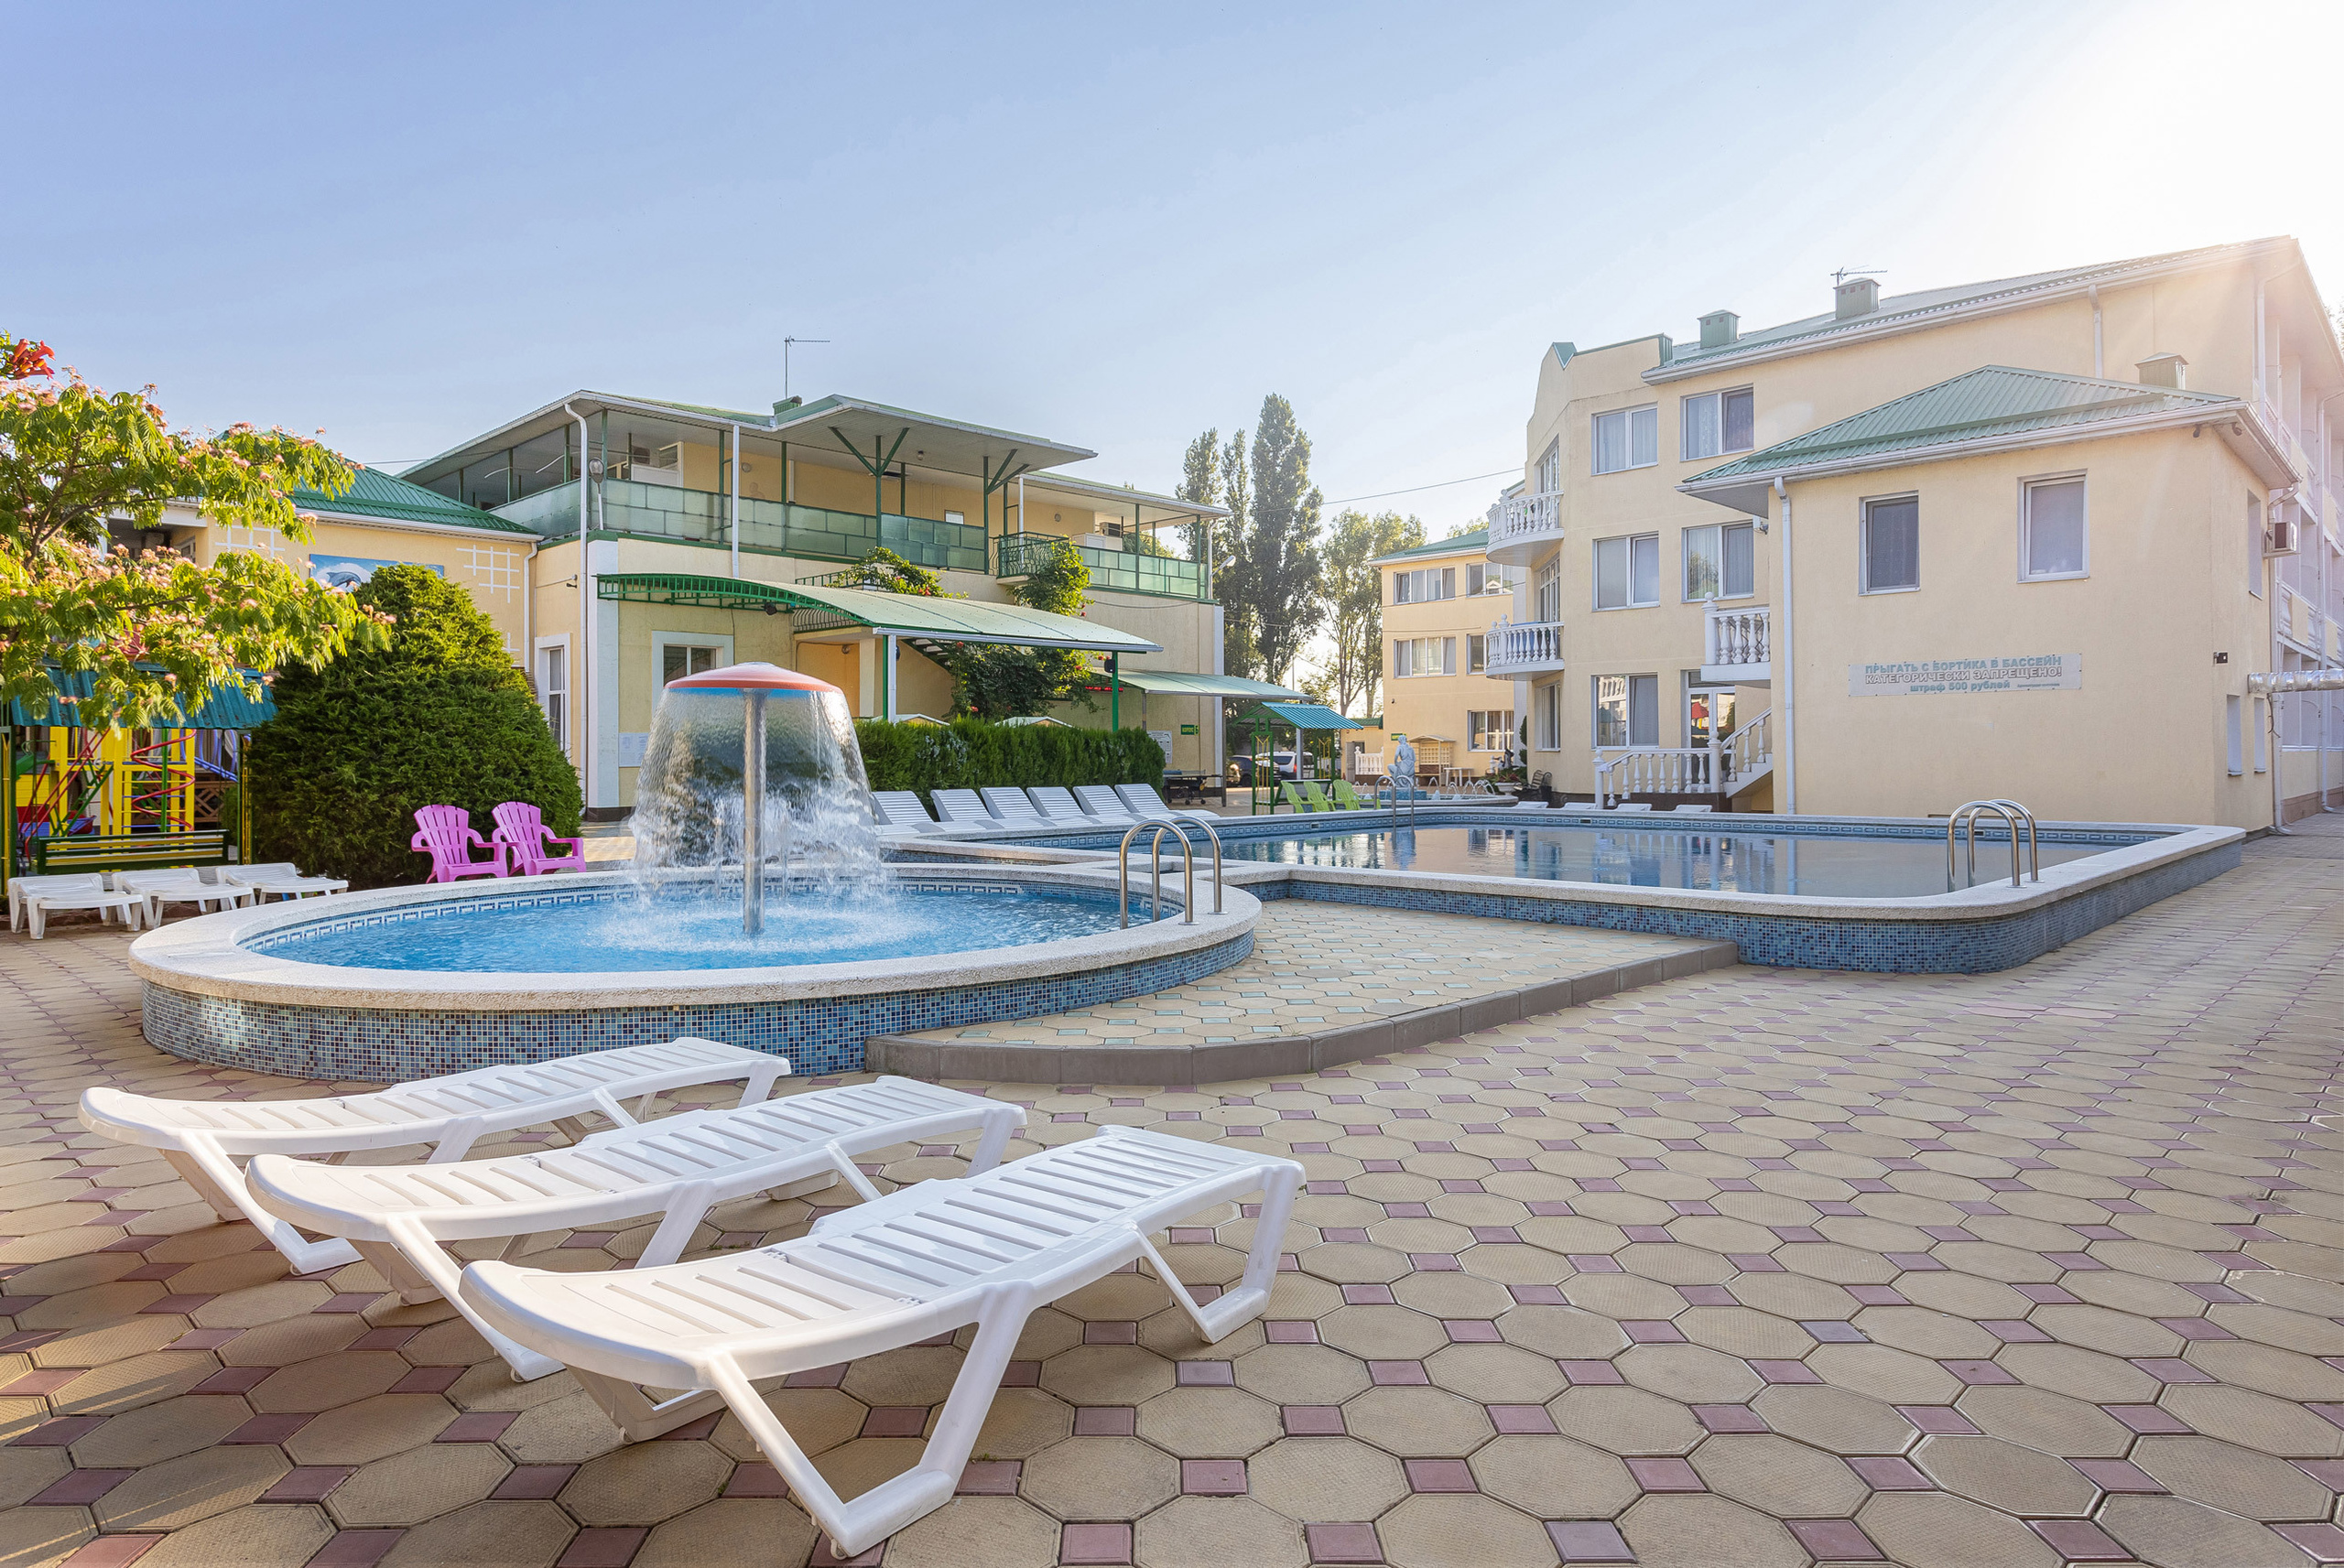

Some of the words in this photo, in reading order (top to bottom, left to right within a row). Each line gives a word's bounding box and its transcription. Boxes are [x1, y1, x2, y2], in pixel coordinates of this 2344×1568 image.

[1865, 663, 1918, 675] ПРЫГАТЬ
[1921, 663, 1929, 672] С
[1932, 660, 1987, 672] БОРТИКА
[1991, 659, 1999, 668] В
[2002, 655, 2062, 668] БАССЕЙН
[1865, 670, 1970, 685] КАТЕГОРИЧЕСКИ
[1973, 666, 2063, 680] ЗАПРЕЩЕНО!
[1910, 683, 1946, 693] штраф
[1948, 681, 1968, 691] 500
[1970, 680, 2011, 691] рублей
